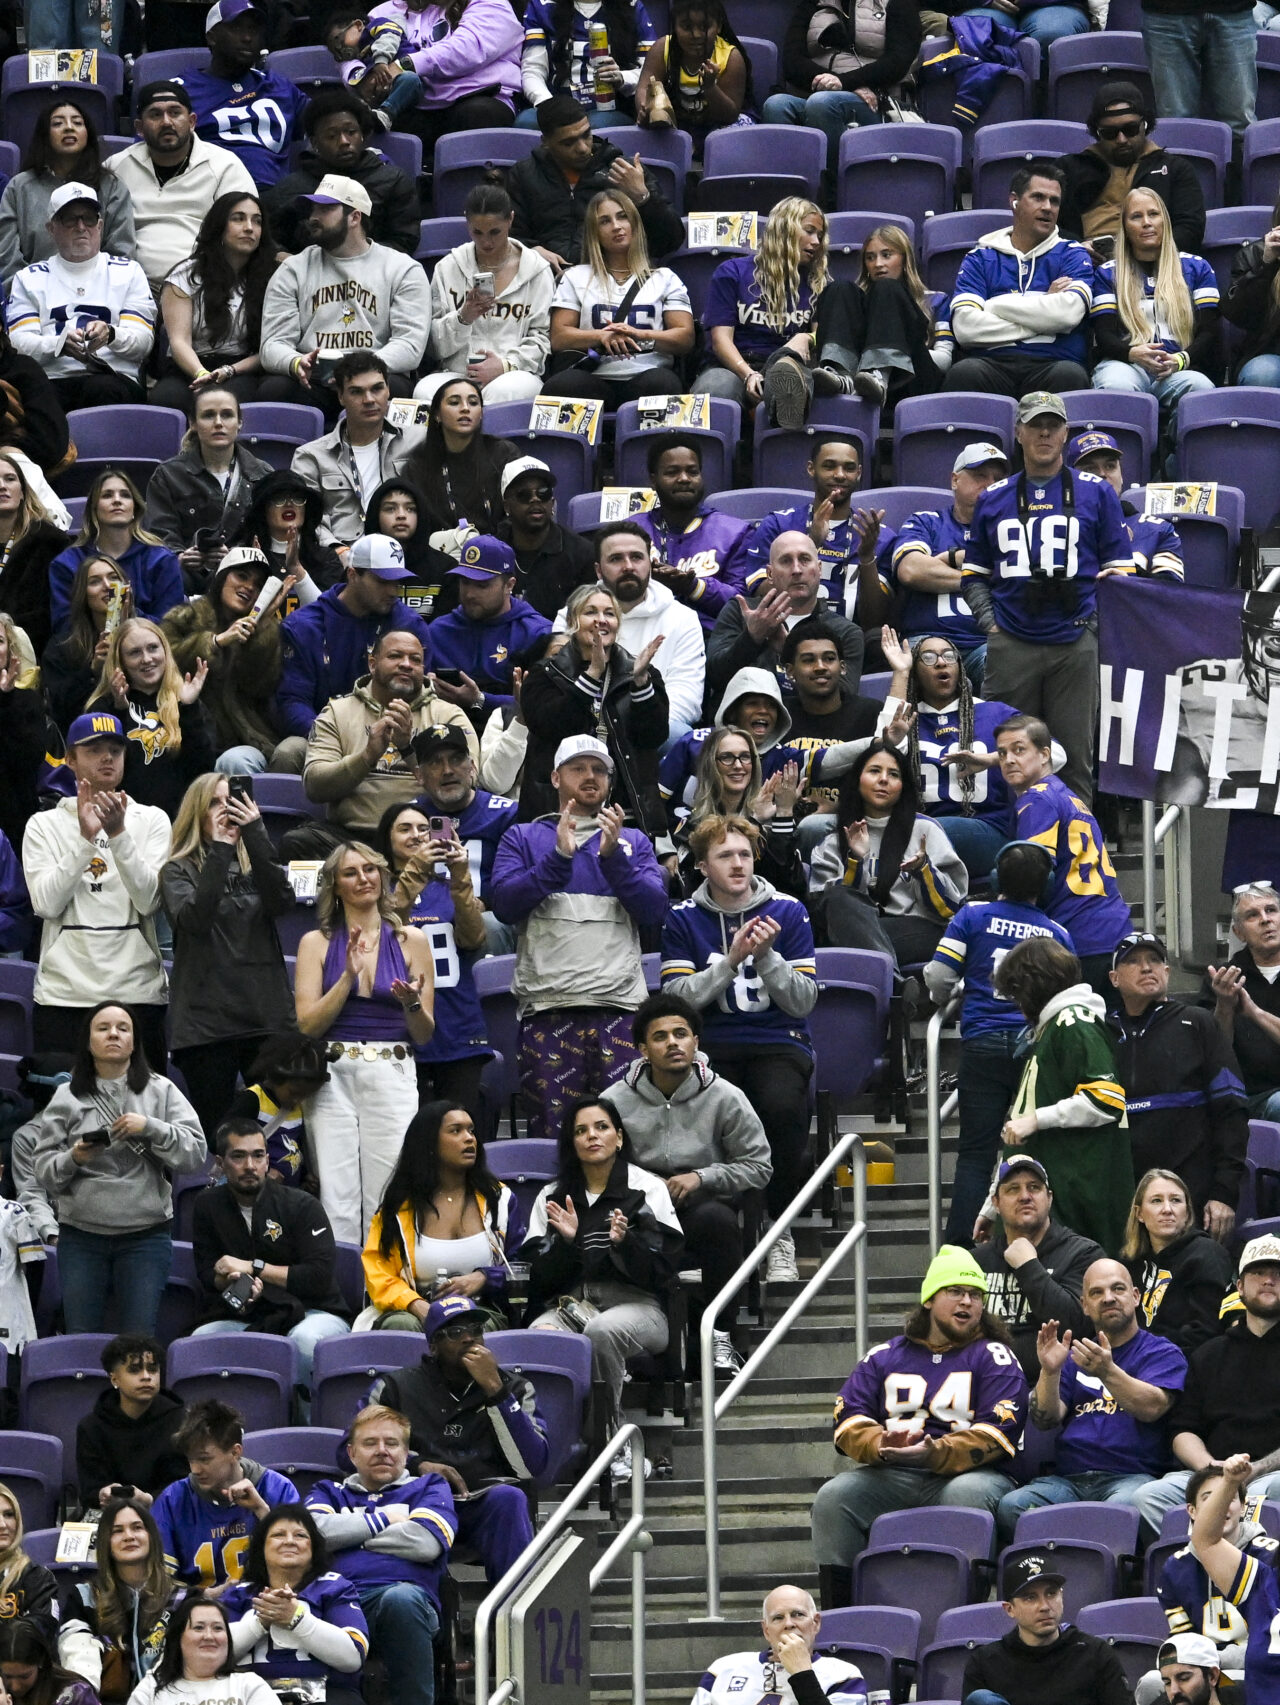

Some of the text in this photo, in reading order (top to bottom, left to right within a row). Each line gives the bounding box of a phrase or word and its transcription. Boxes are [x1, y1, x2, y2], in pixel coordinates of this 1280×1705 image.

[311, 281, 379, 316] MINNSOTA
[315, 330, 373, 350] VIKINGS
[999, 515, 1080, 578] 98
[92, 717, 116, 734] MIN
[986, 917, 1054, 939] JEFFERSON
[885, 1371, 975, 1434] 84
[1017, 1557, 1045, 1569] VIKINGS
[535, 1607, 583, 1686] 124
